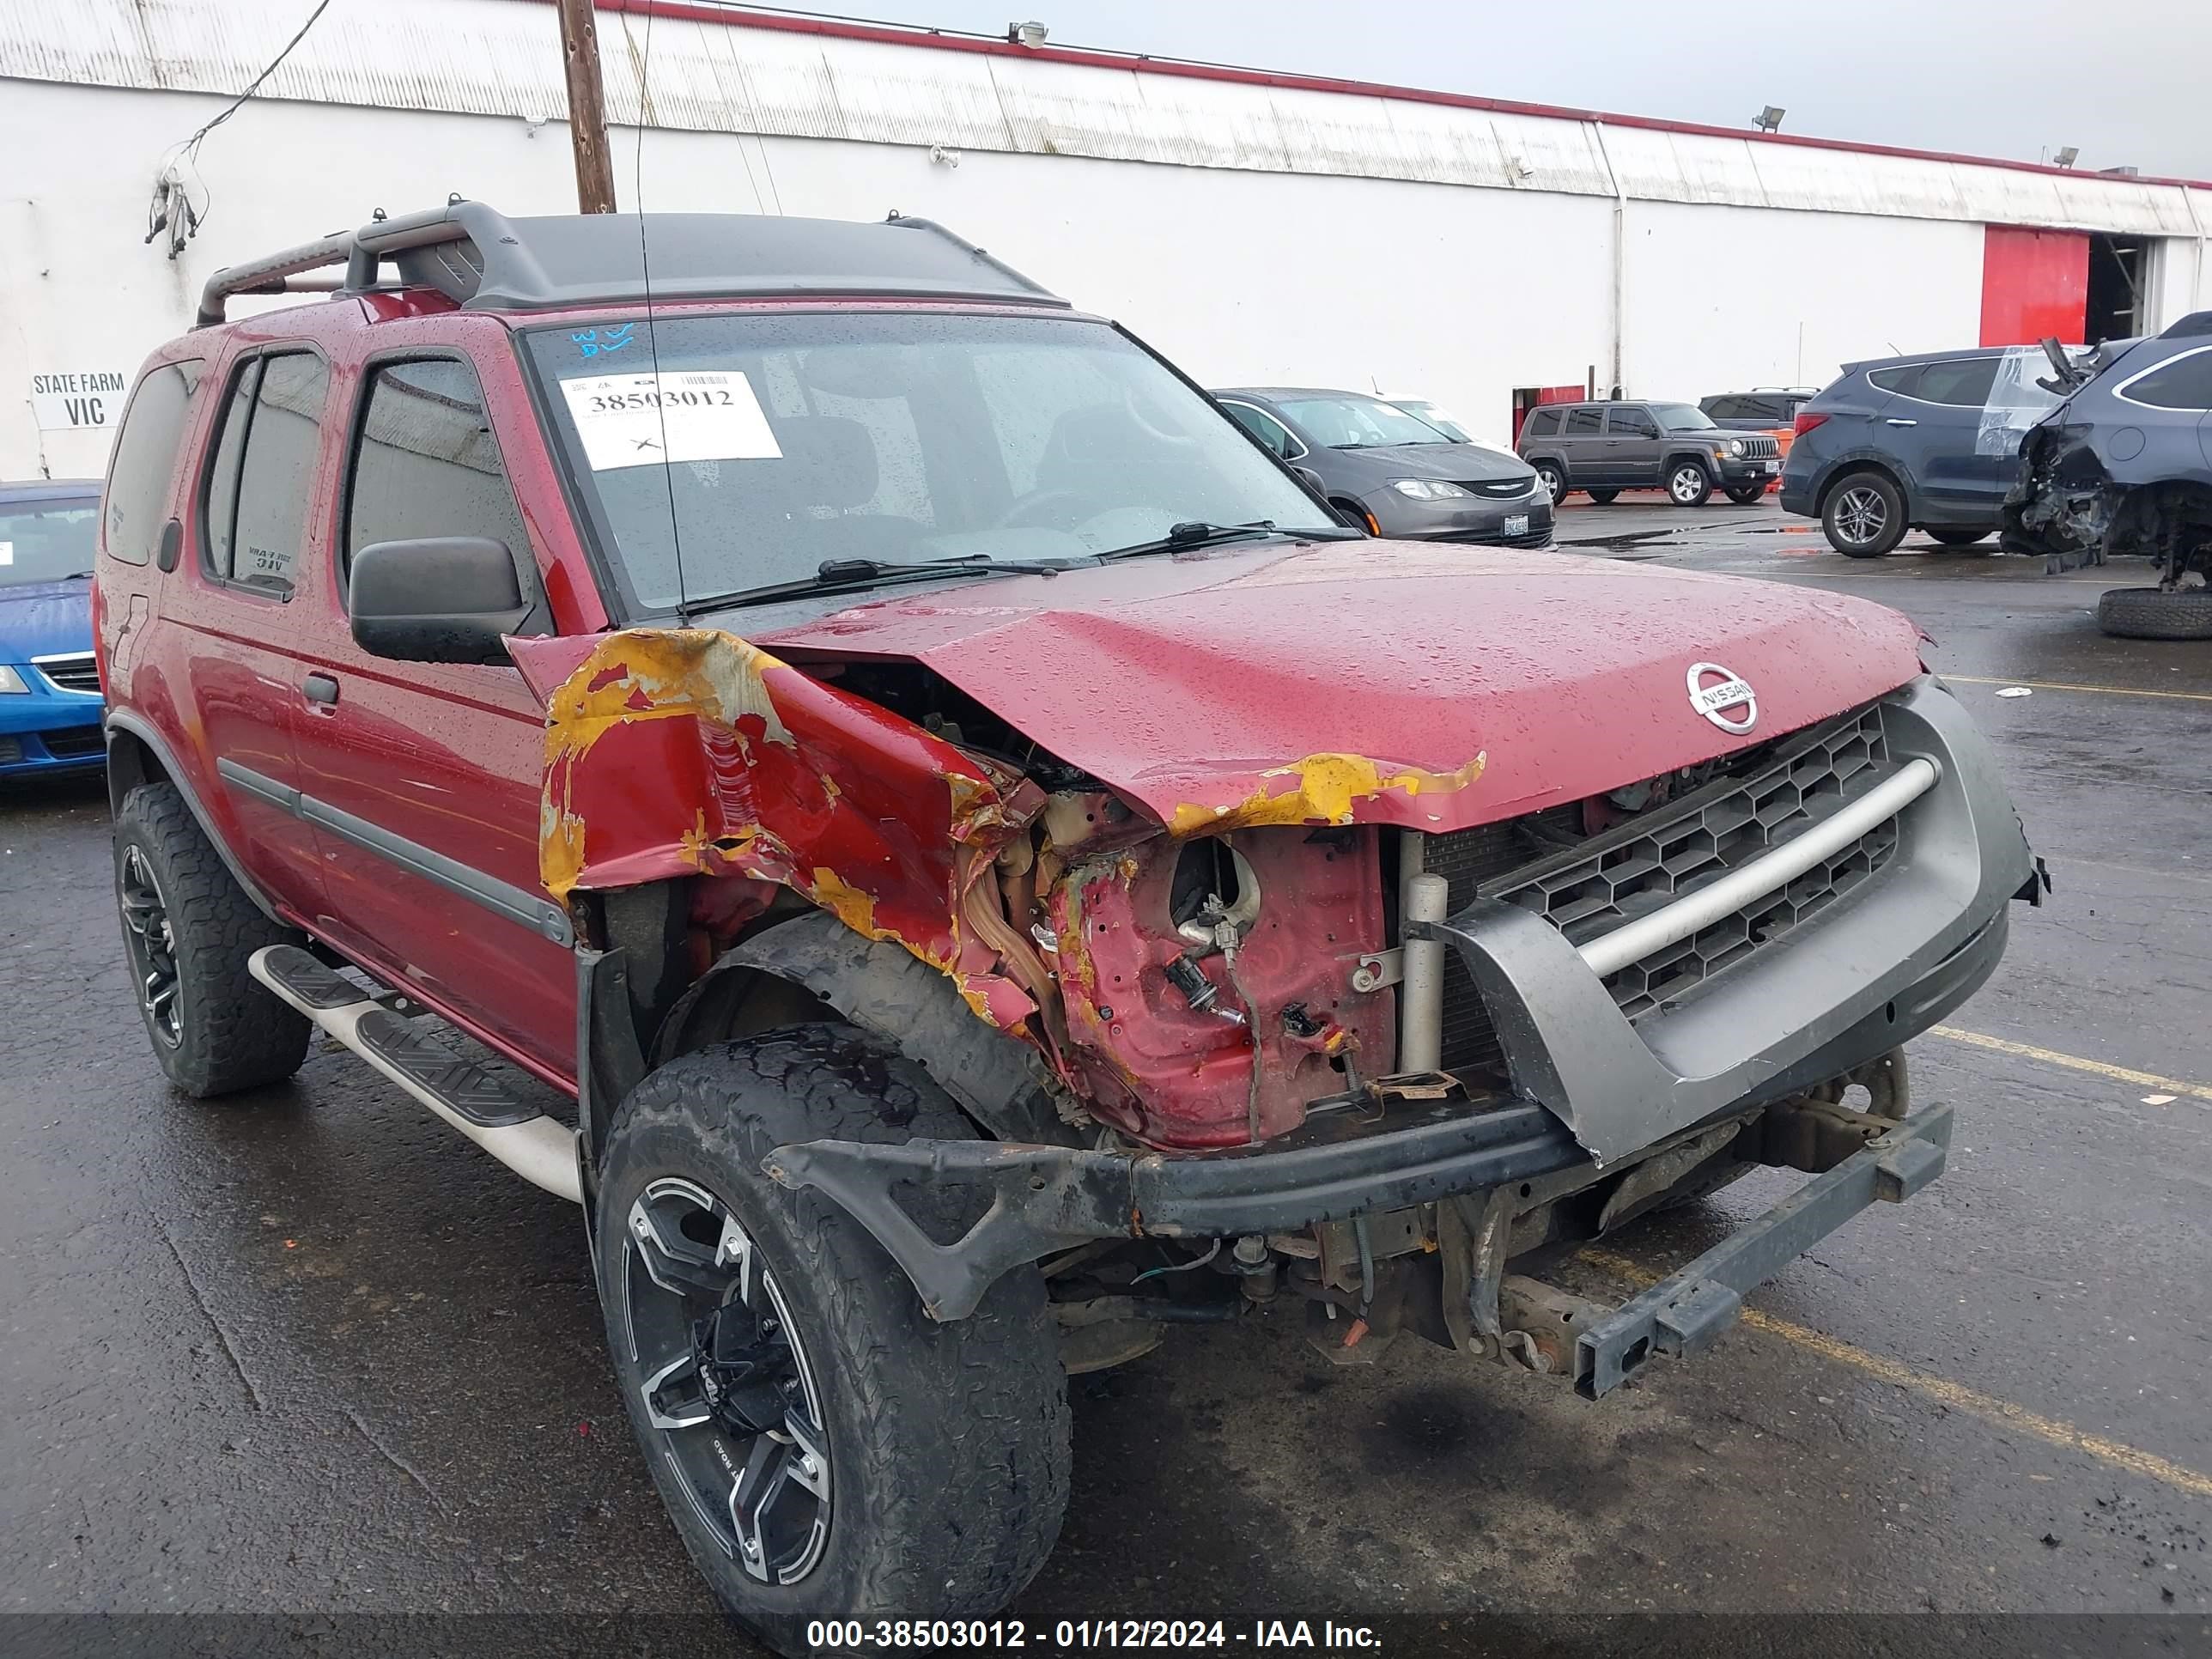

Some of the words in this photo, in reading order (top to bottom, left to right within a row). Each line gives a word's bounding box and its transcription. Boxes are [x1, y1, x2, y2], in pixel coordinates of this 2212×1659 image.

[33, 374, 77, 394] STATE
[81, 373, 125, 392] FARM
[64, 398, 105, 425] VIC
[589, 390, 735, 412] 38503012
[1702, 683, 1751, 707] NISSAN
[714, 1439, 732, 1469] ROAD
